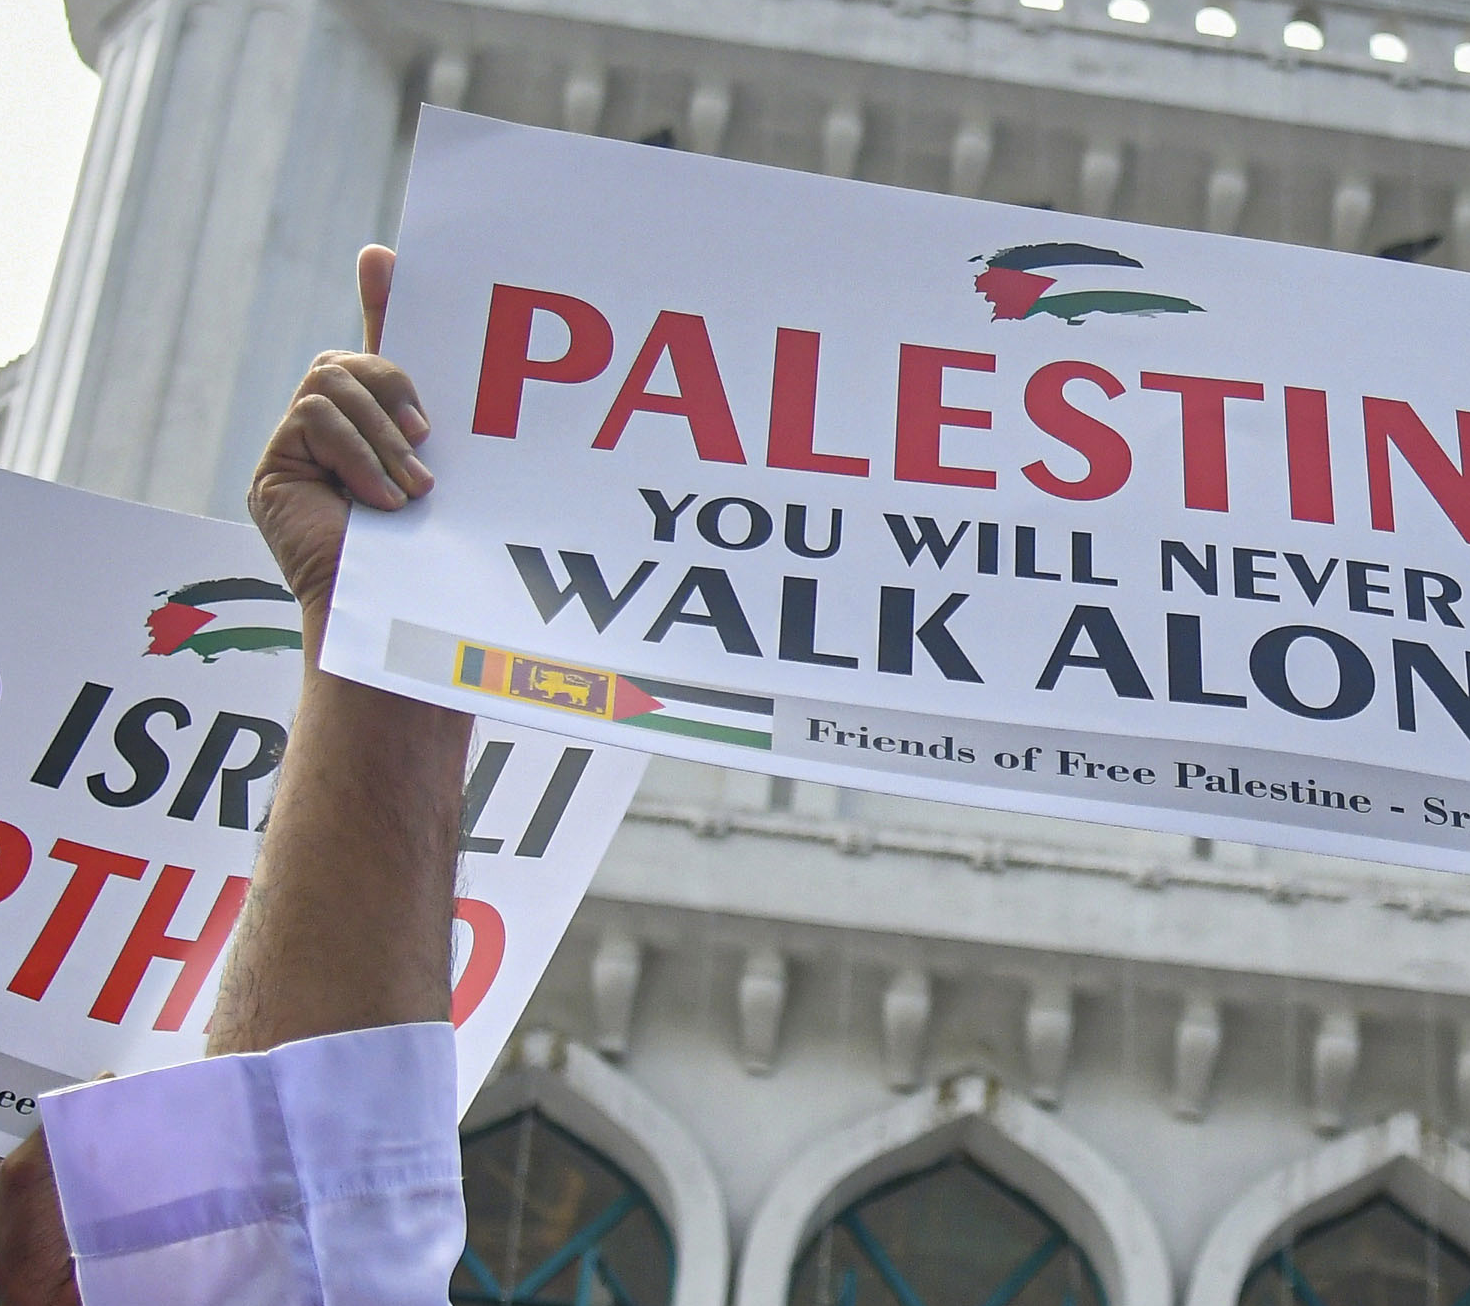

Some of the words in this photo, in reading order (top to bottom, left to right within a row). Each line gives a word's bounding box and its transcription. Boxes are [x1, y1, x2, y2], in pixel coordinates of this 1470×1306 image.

[506, 543, 984, 685] WALK
[638, 489, 843, 559] YOU
[883, 513, 1118, 586] WILL
[1162, 540, 1464, 629] NEVER
[30, 681, 594, 859] ISRLI
[805, 717, 976, 765] Friends
[994, 746, 1043, 773] of
[1056, 749, 1157, 787] Free
[1174, 760, 1372, 815] Palestine
